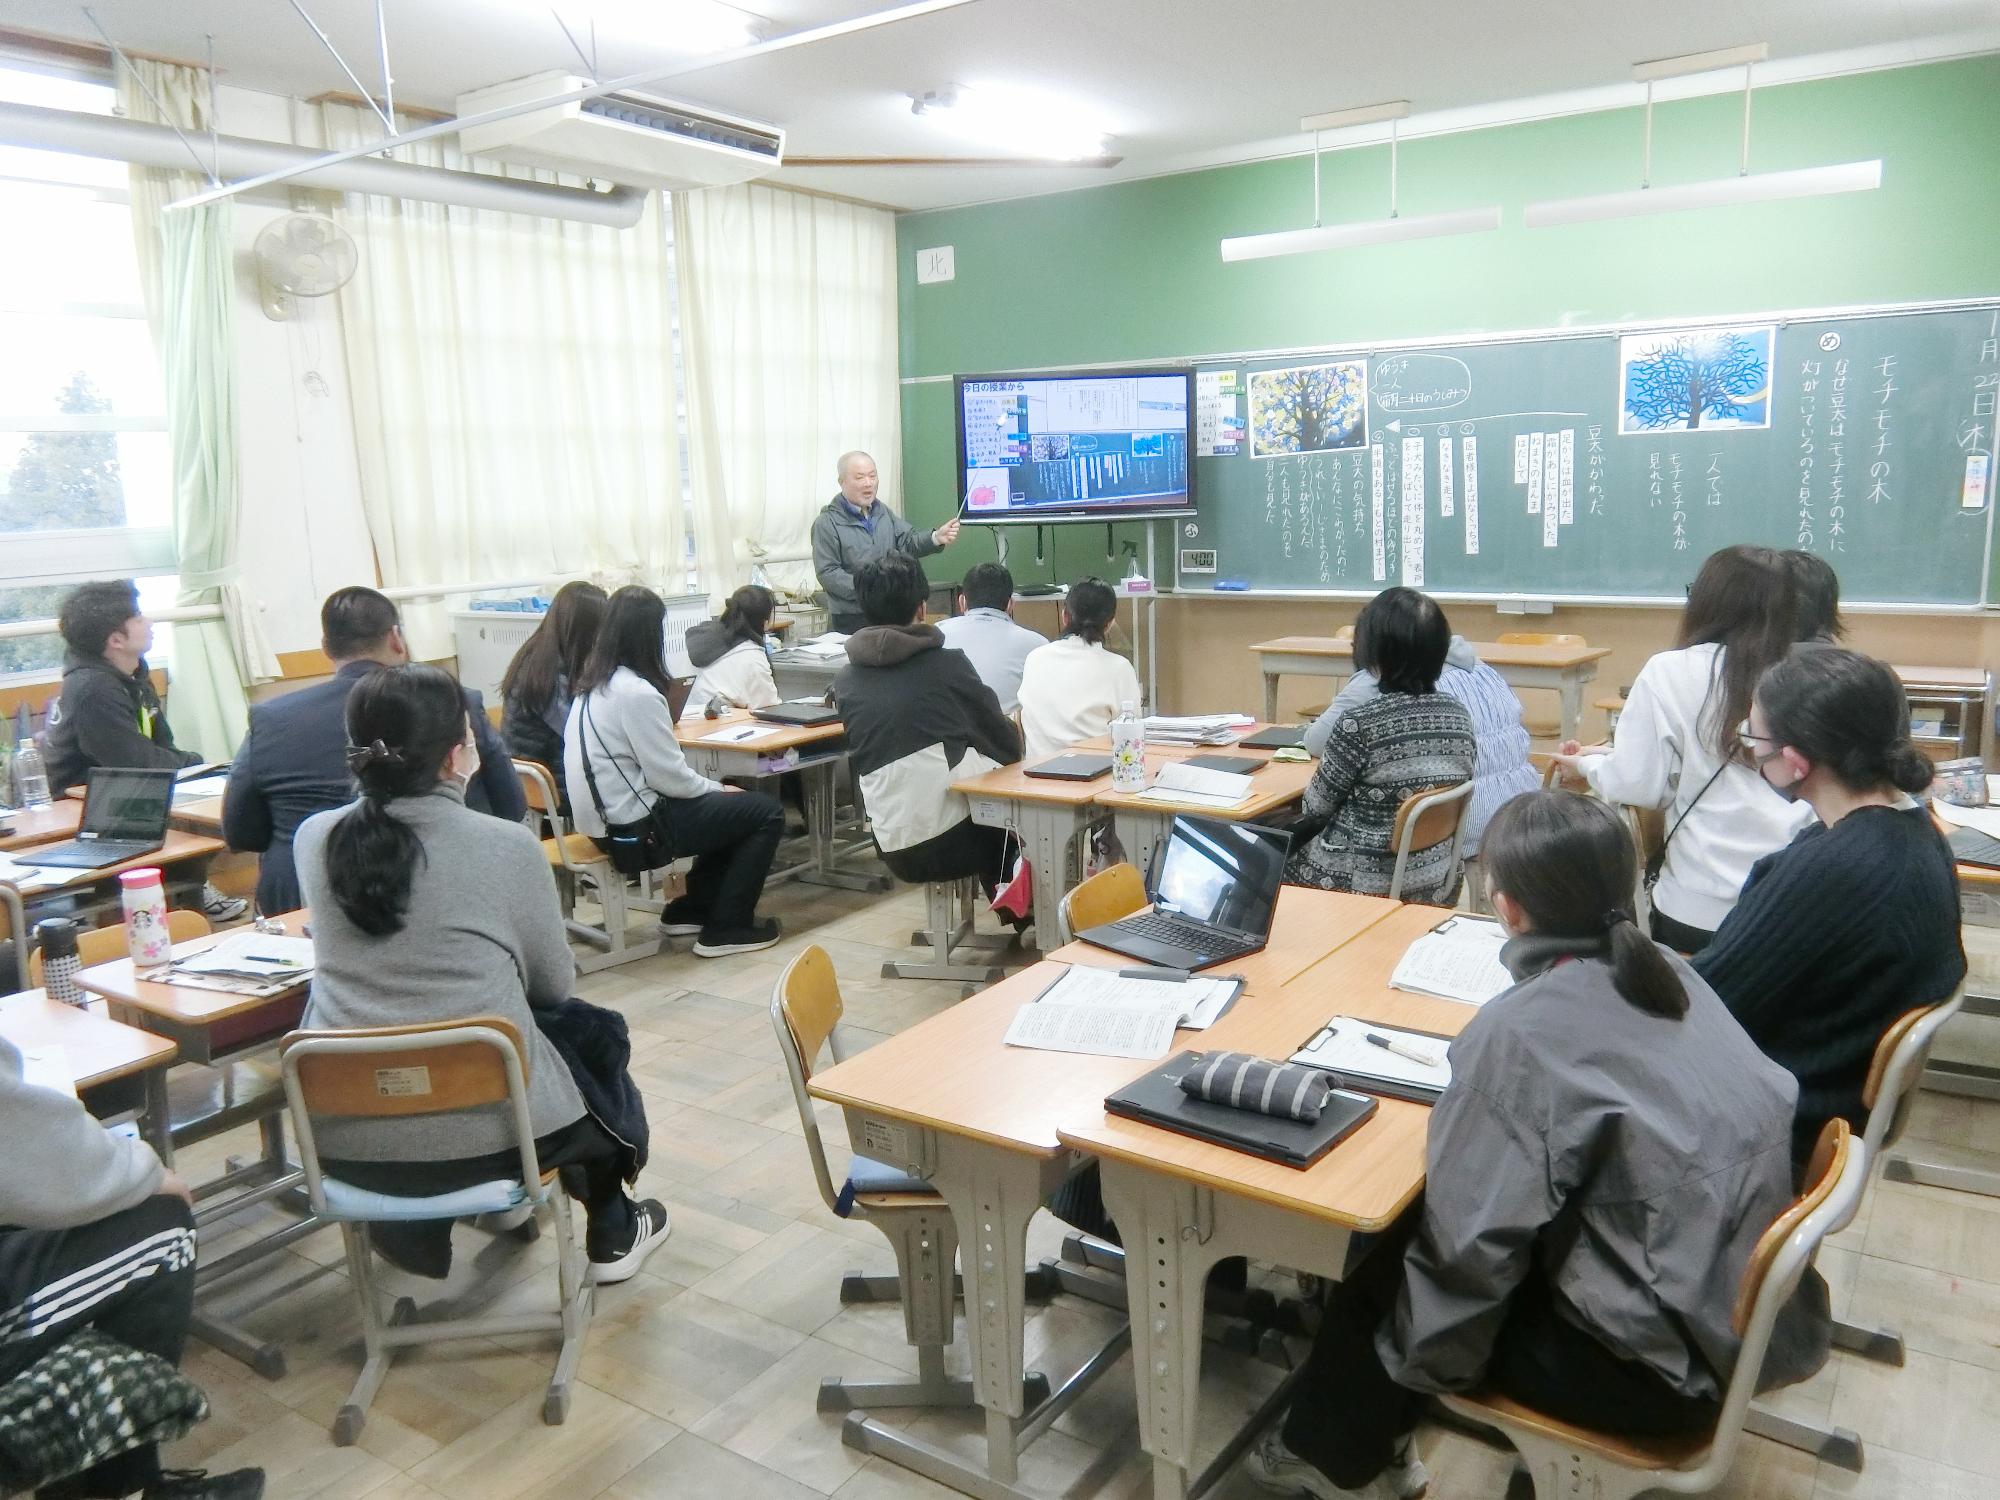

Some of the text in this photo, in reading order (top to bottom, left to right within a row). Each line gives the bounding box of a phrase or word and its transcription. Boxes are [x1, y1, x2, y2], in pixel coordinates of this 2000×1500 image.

[928, 252, 947, 277] 北
[963, 382, 1025, 392] 今日の授業から
[1866, 355, 1899, 504] モチモチの木
[1586, 424, 1606, 515] 豆太がかわった
[1649, 452, 1664, 507] 見れない
[1669, 453, 1691, 551] モチモチの木が
